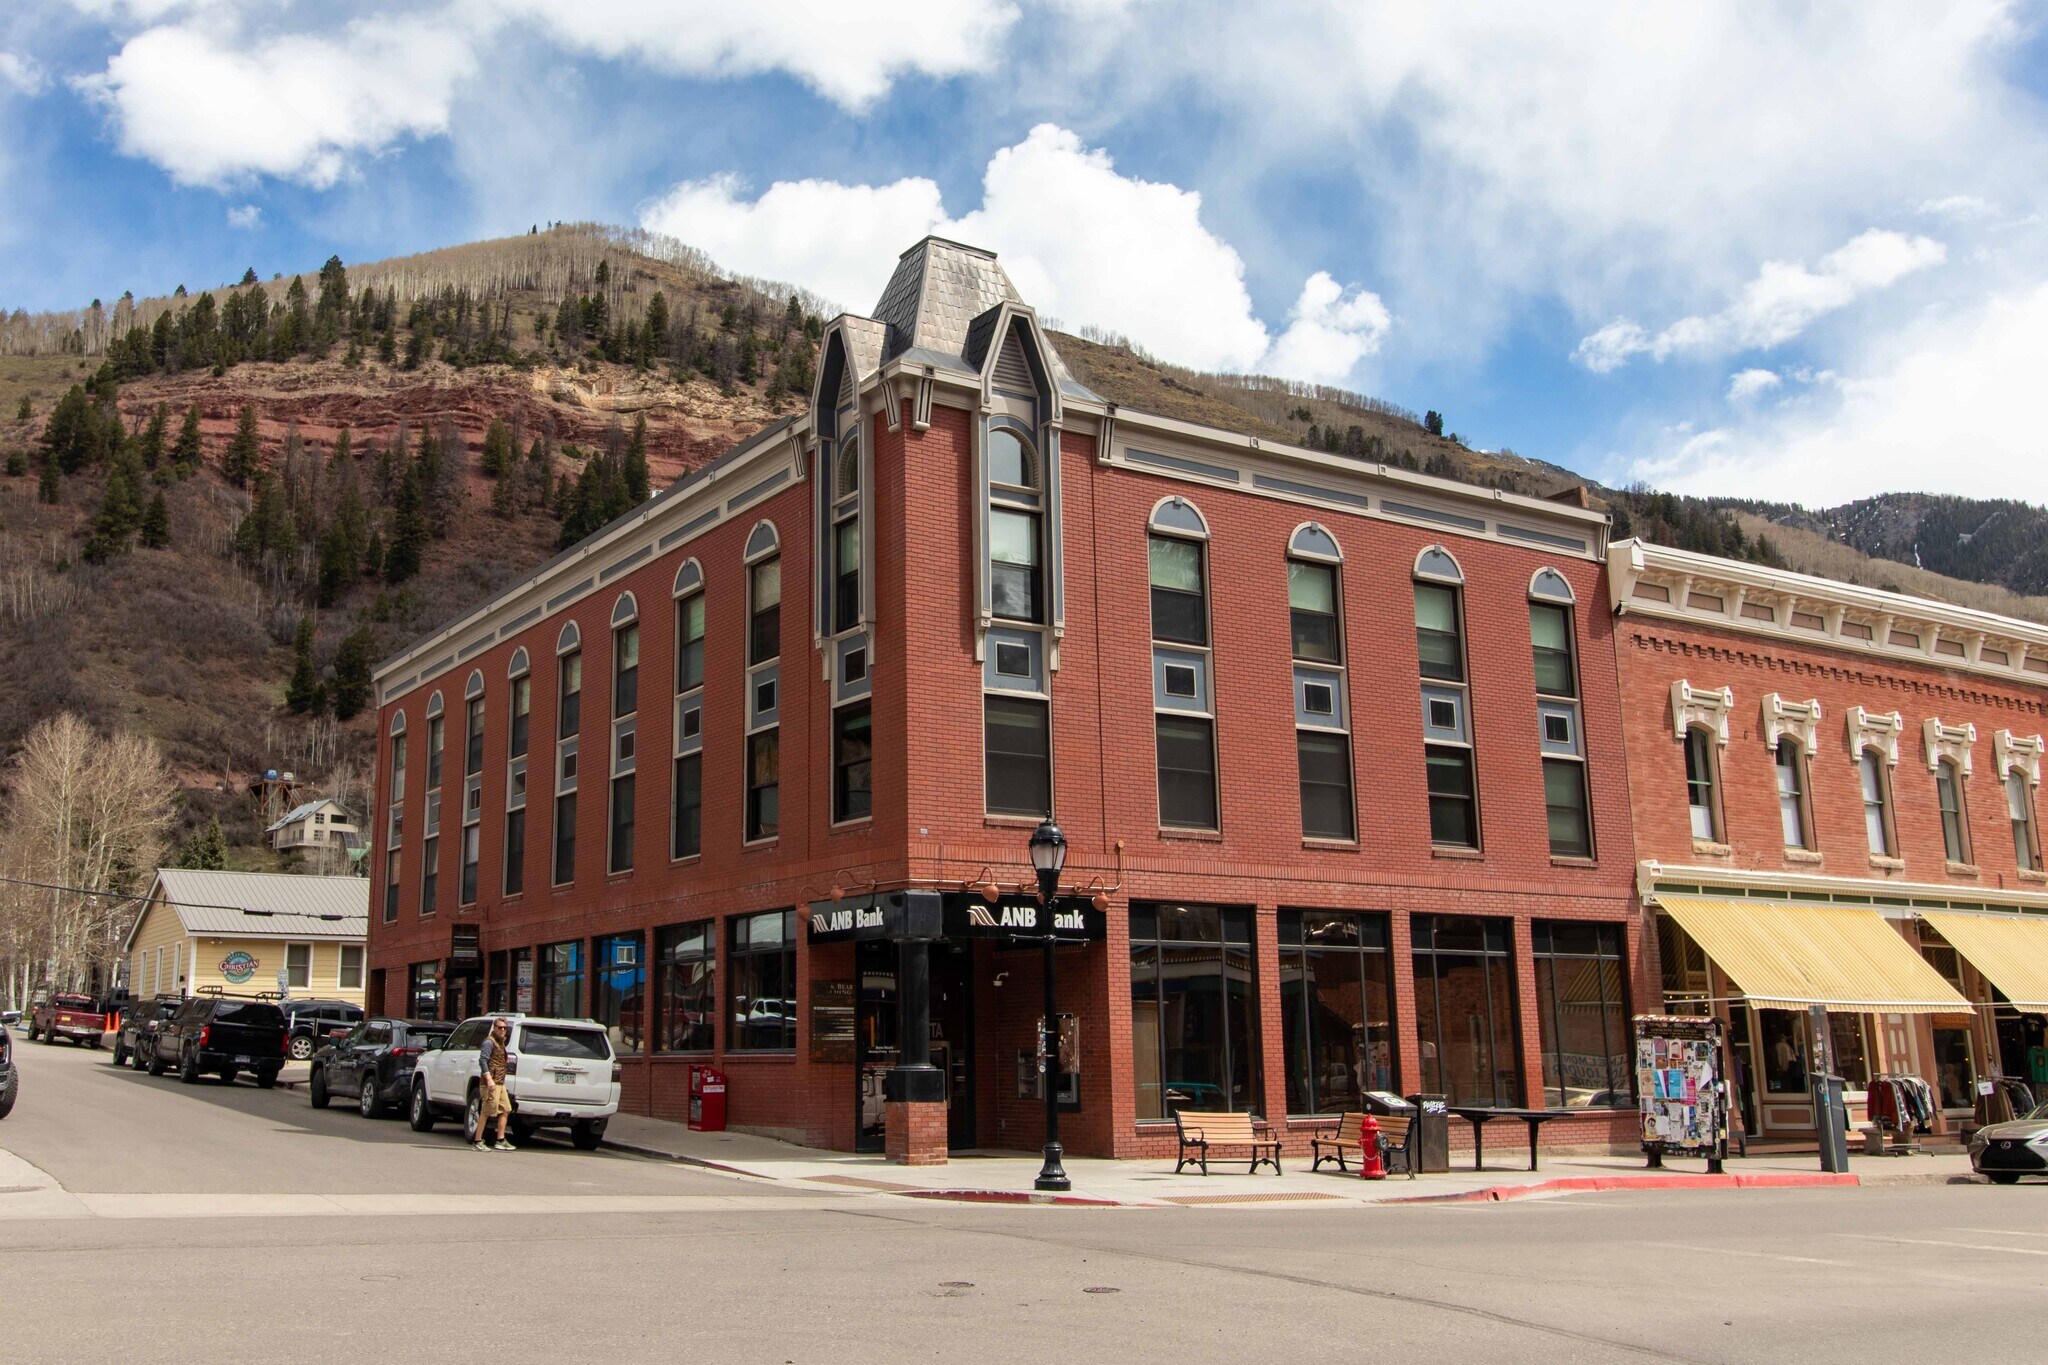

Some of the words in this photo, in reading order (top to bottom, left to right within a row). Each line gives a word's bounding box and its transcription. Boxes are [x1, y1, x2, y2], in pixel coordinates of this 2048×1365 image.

[830, 911, 853, 931] ANB
[856, 906, 883, 928] Bank
[1000, 906, 1037, 927] ANB
[1053, 909, 1084, 929] ank
[220, 959, 258, 973] CHRISTIAN
